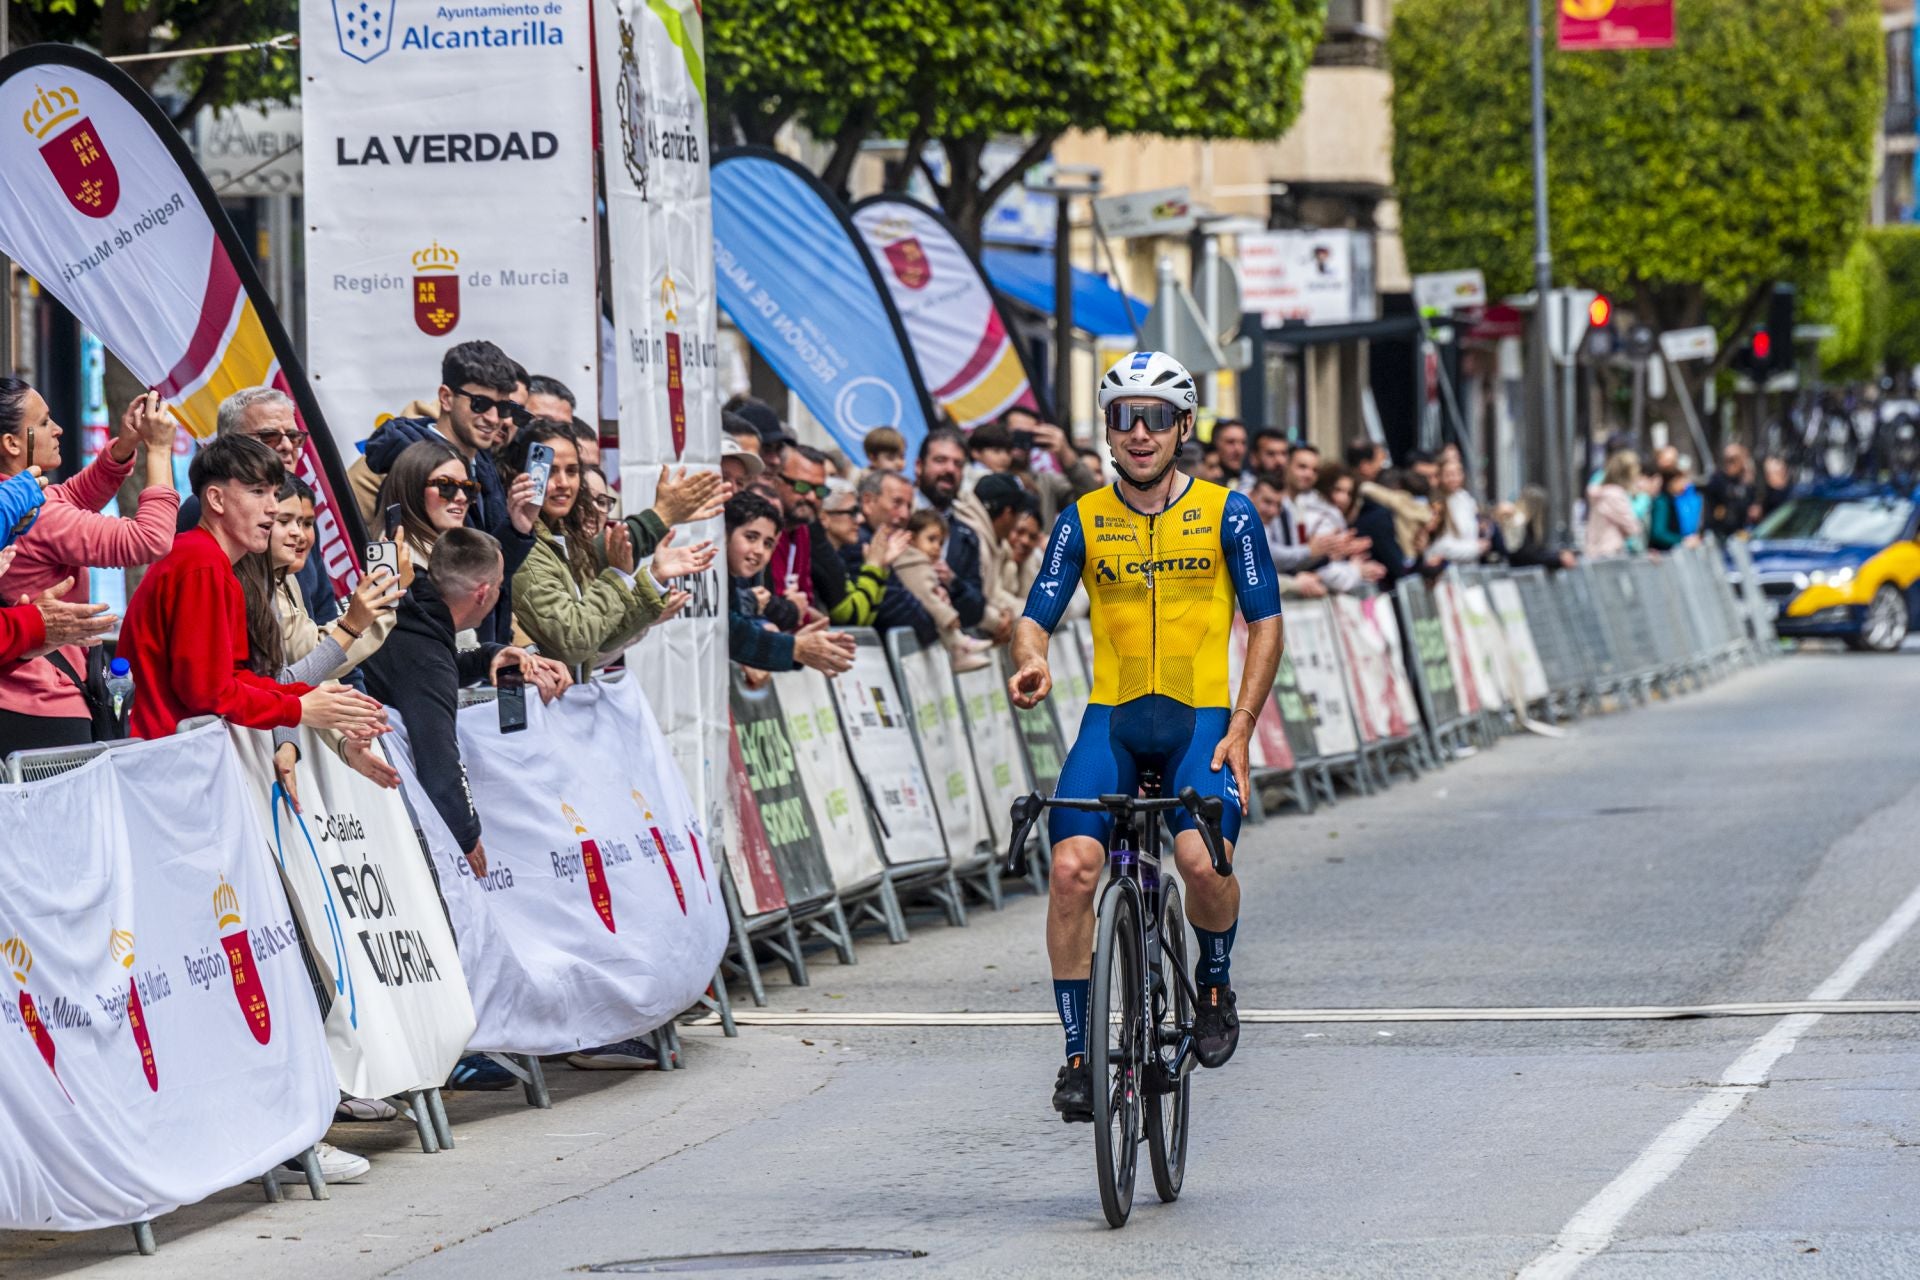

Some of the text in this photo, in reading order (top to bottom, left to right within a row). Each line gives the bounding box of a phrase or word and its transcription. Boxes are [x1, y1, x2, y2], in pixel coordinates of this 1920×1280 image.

[437, 3, 562, 20] Ayuntamiento de
[402, 21, 563, 50] Alcantarilla
[336, 131, 559, 166] LA VERDAD
[334, 269, 569, 293] Región de Murcia
[1049, 523, 1072, 575] CORTIZO
[1096, 534, 1138, 542] ABANCA
[1126, 557, 1211, 574] CORTIZO
[1241, 535, 1259, 586] CORTIZO
[184, 946, 226, 990] Región
[251, 928, 268, 962] de
[1061, 992, 1073, 1023] CORTIZO
